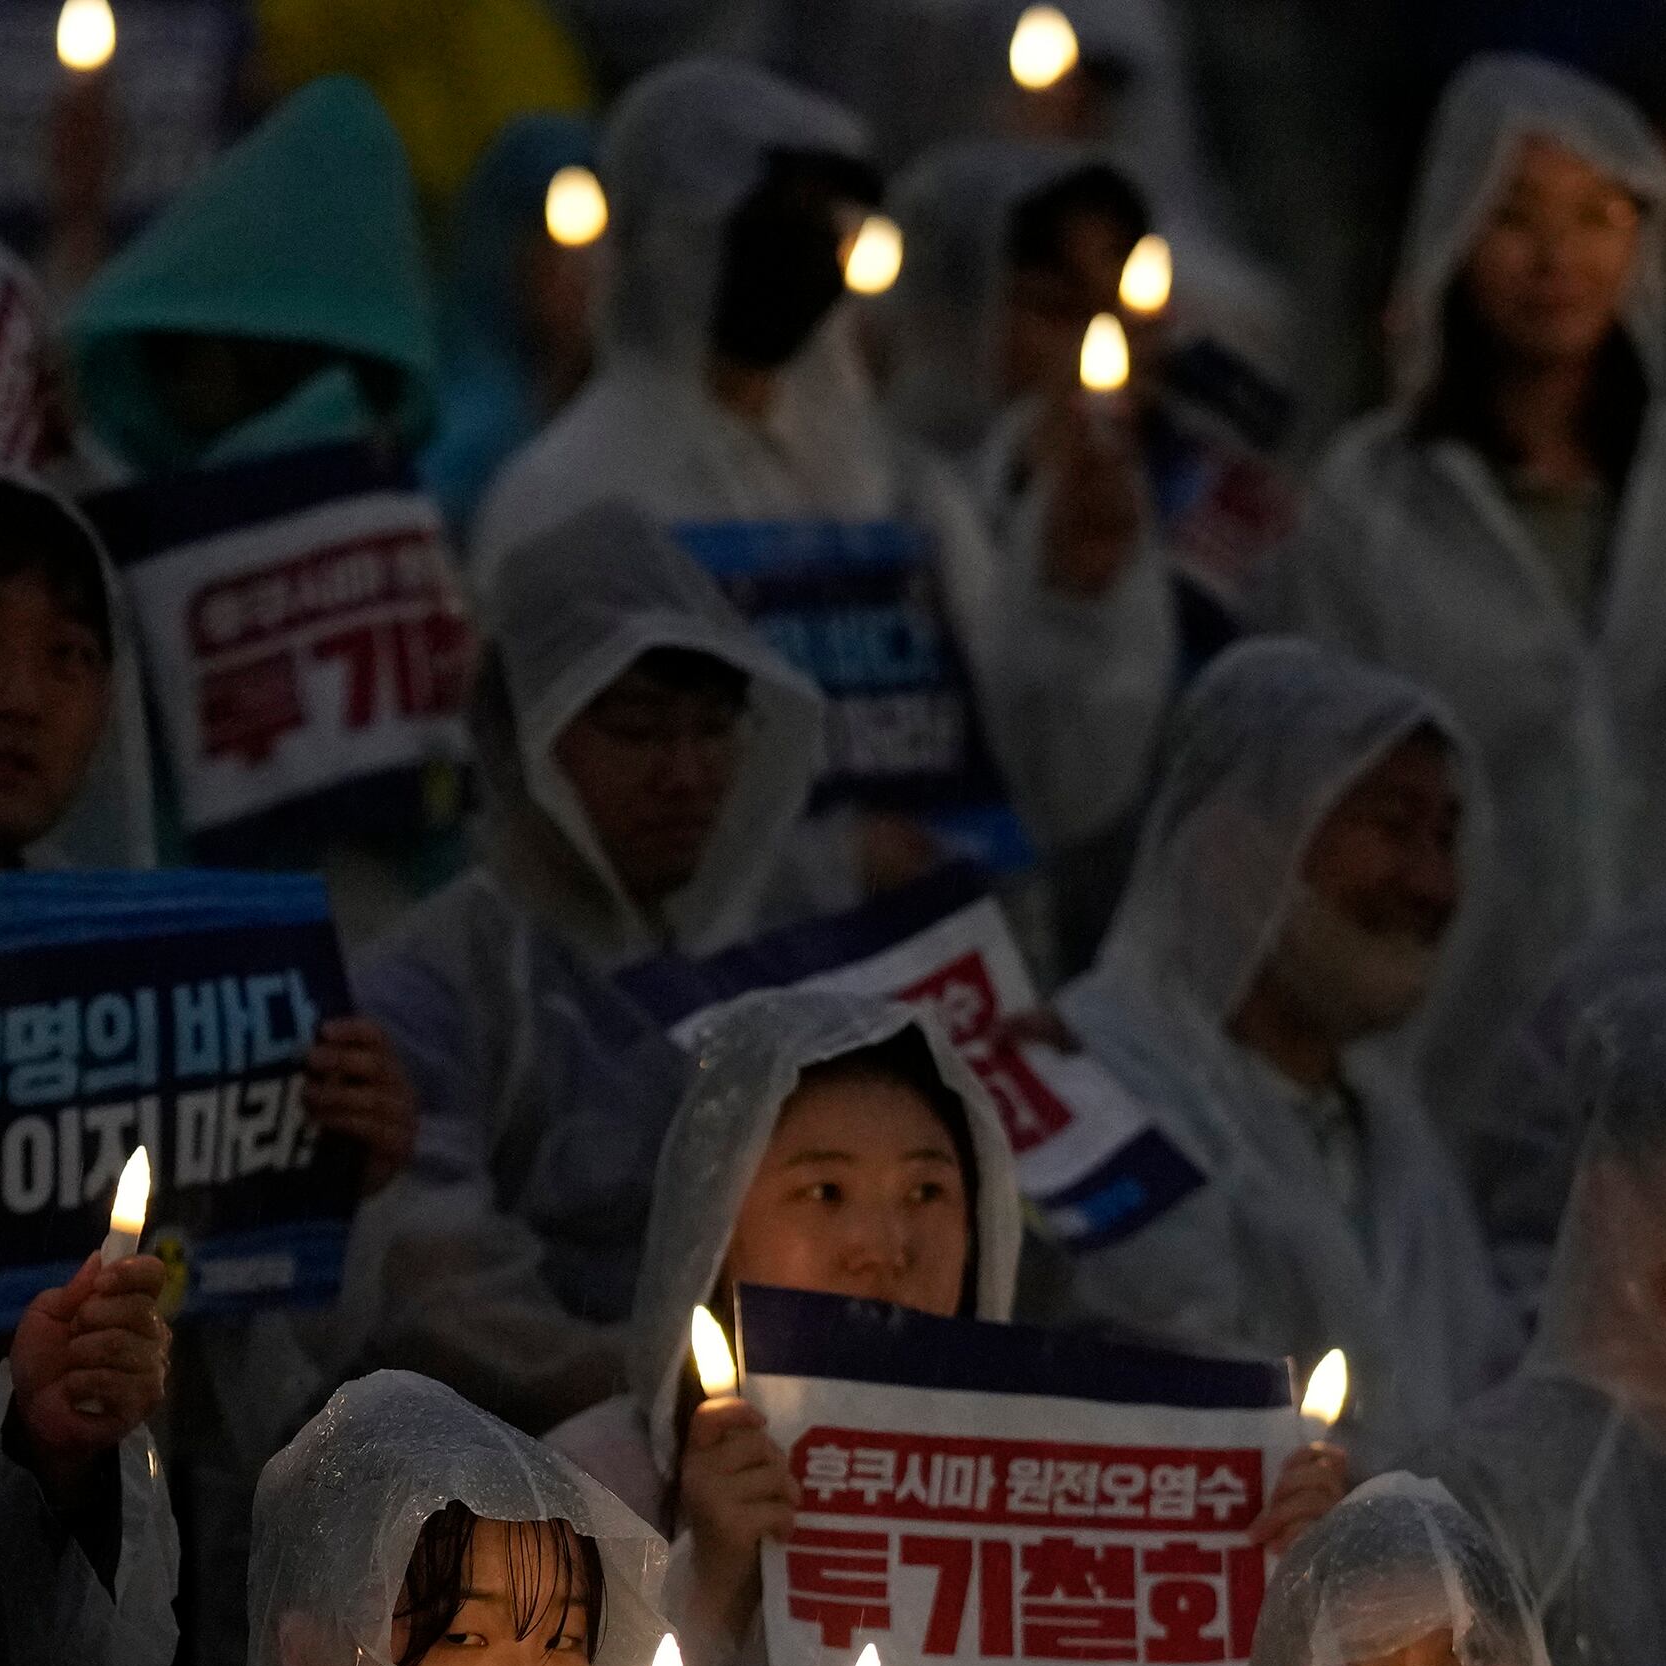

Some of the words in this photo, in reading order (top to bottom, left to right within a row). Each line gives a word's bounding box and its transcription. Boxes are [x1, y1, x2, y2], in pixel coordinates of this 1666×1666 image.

[804, 1443, 997, 1513] 후쿠시마
[1005, 1456, 1248, 1522] 원전오염수
[787, 1526, 1265, 1663] 투기철회
